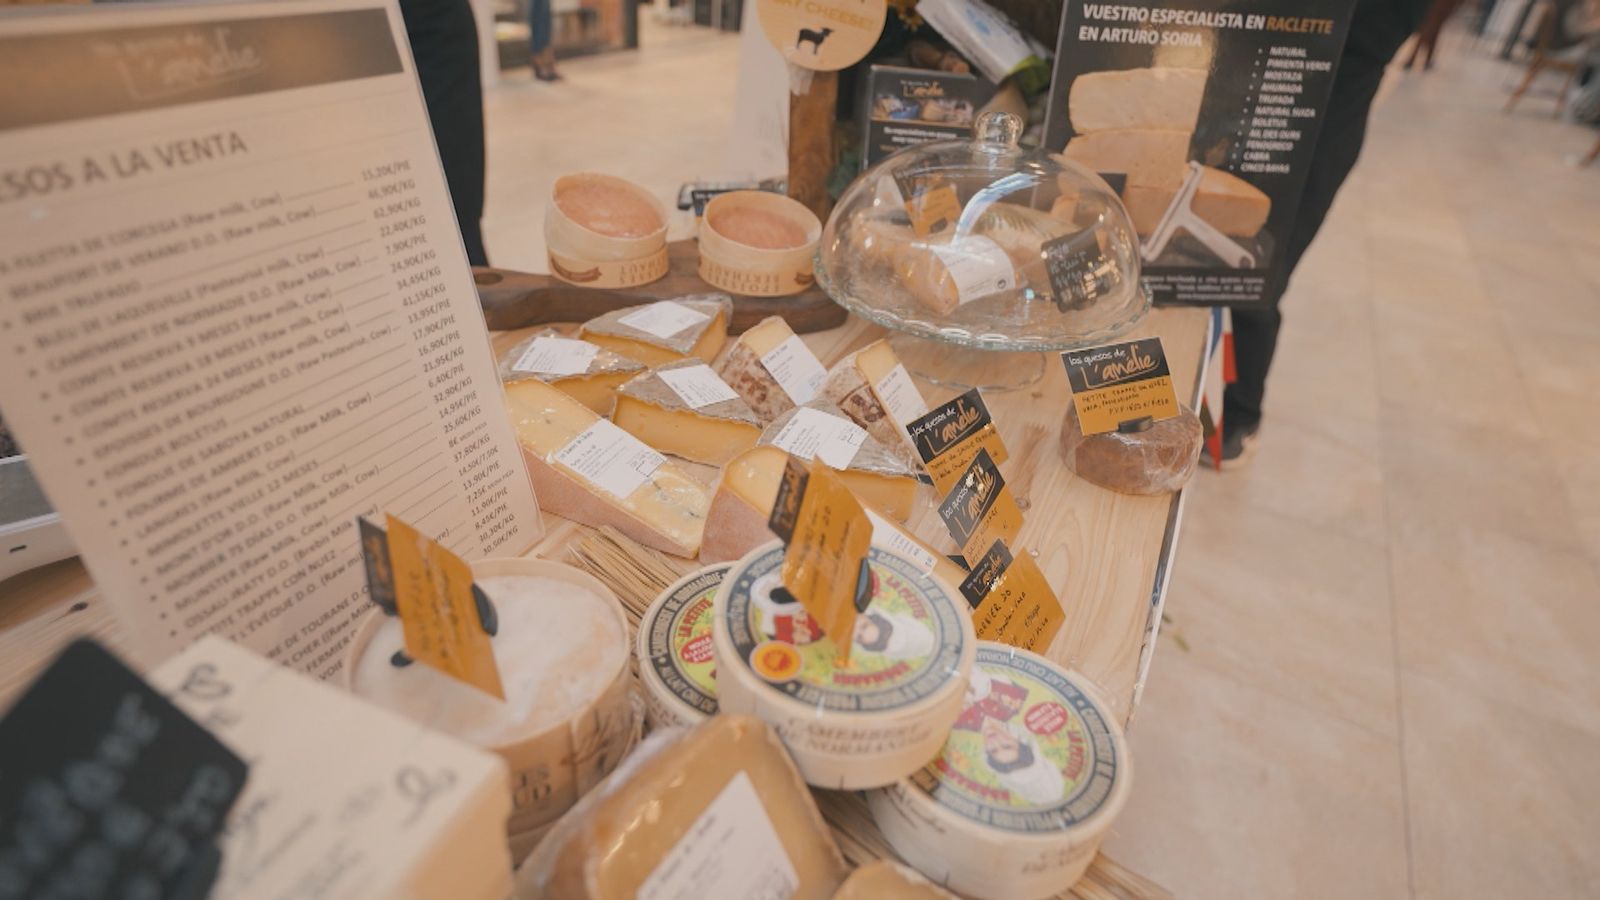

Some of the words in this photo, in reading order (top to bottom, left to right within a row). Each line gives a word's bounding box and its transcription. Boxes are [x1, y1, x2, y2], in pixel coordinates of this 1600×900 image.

[1083, 4, 1149, 22] VUESTRO
[1150, 11, 1243, 29] ESPECIALISTA
[1245, 15, 1266, 30] EN
[1266, 17, 1334, 34] RACLETTE
[1079, 26, 1098, 41] EN
[1100, 27, 1159, 44] ARTURO
[1160, 30, 1202, 46] SORIA
[82, 155, 107, 186] A
[110, 147, 153, 180] LA
[154, 130, 249, 170] VENTA
[335, 255, 361, 273] Cow)
[303, 286, 331, 306] Cow)
[317, 303, 344, 322] Cow)
[324, 321, 350, 341] Cow)
[369, 324, 391, 341] Cow)
[1084, 352, 1112, 366] quesos
[1113, 348, 1127, 358] de
[251, 402, 303, 435] NATURAL
[290, 417, 317, 438] (Raw
[346, 391, 371, 411] Cow)
[924, 413, 947, 432] quesos
[266, 449, 295, 472] Cow)
[267, 478, 280, 492] 12
[283, 458, 318, 484] MESES
[263, 494, 290, 517] (Raw
[321, 462, 347, 484] Cow)
[301, 493, 326, 515] (Raw
[240, 549, 268, 573] (Raw
[300, 514, 328, 537] Cow)
[238, 585, 279, 619] TRAPPE
[282, 567, 306, 589] CON
[308, 548, 335, 572] NUEZ
[320, 563, 344, 586] (Raw
[284, 631, 300, 649] DE
[301, 596, 349, 637] TOURANE
[290, 636, 320, 664] CHER
[305, 634, 349, 671] FERMIER
